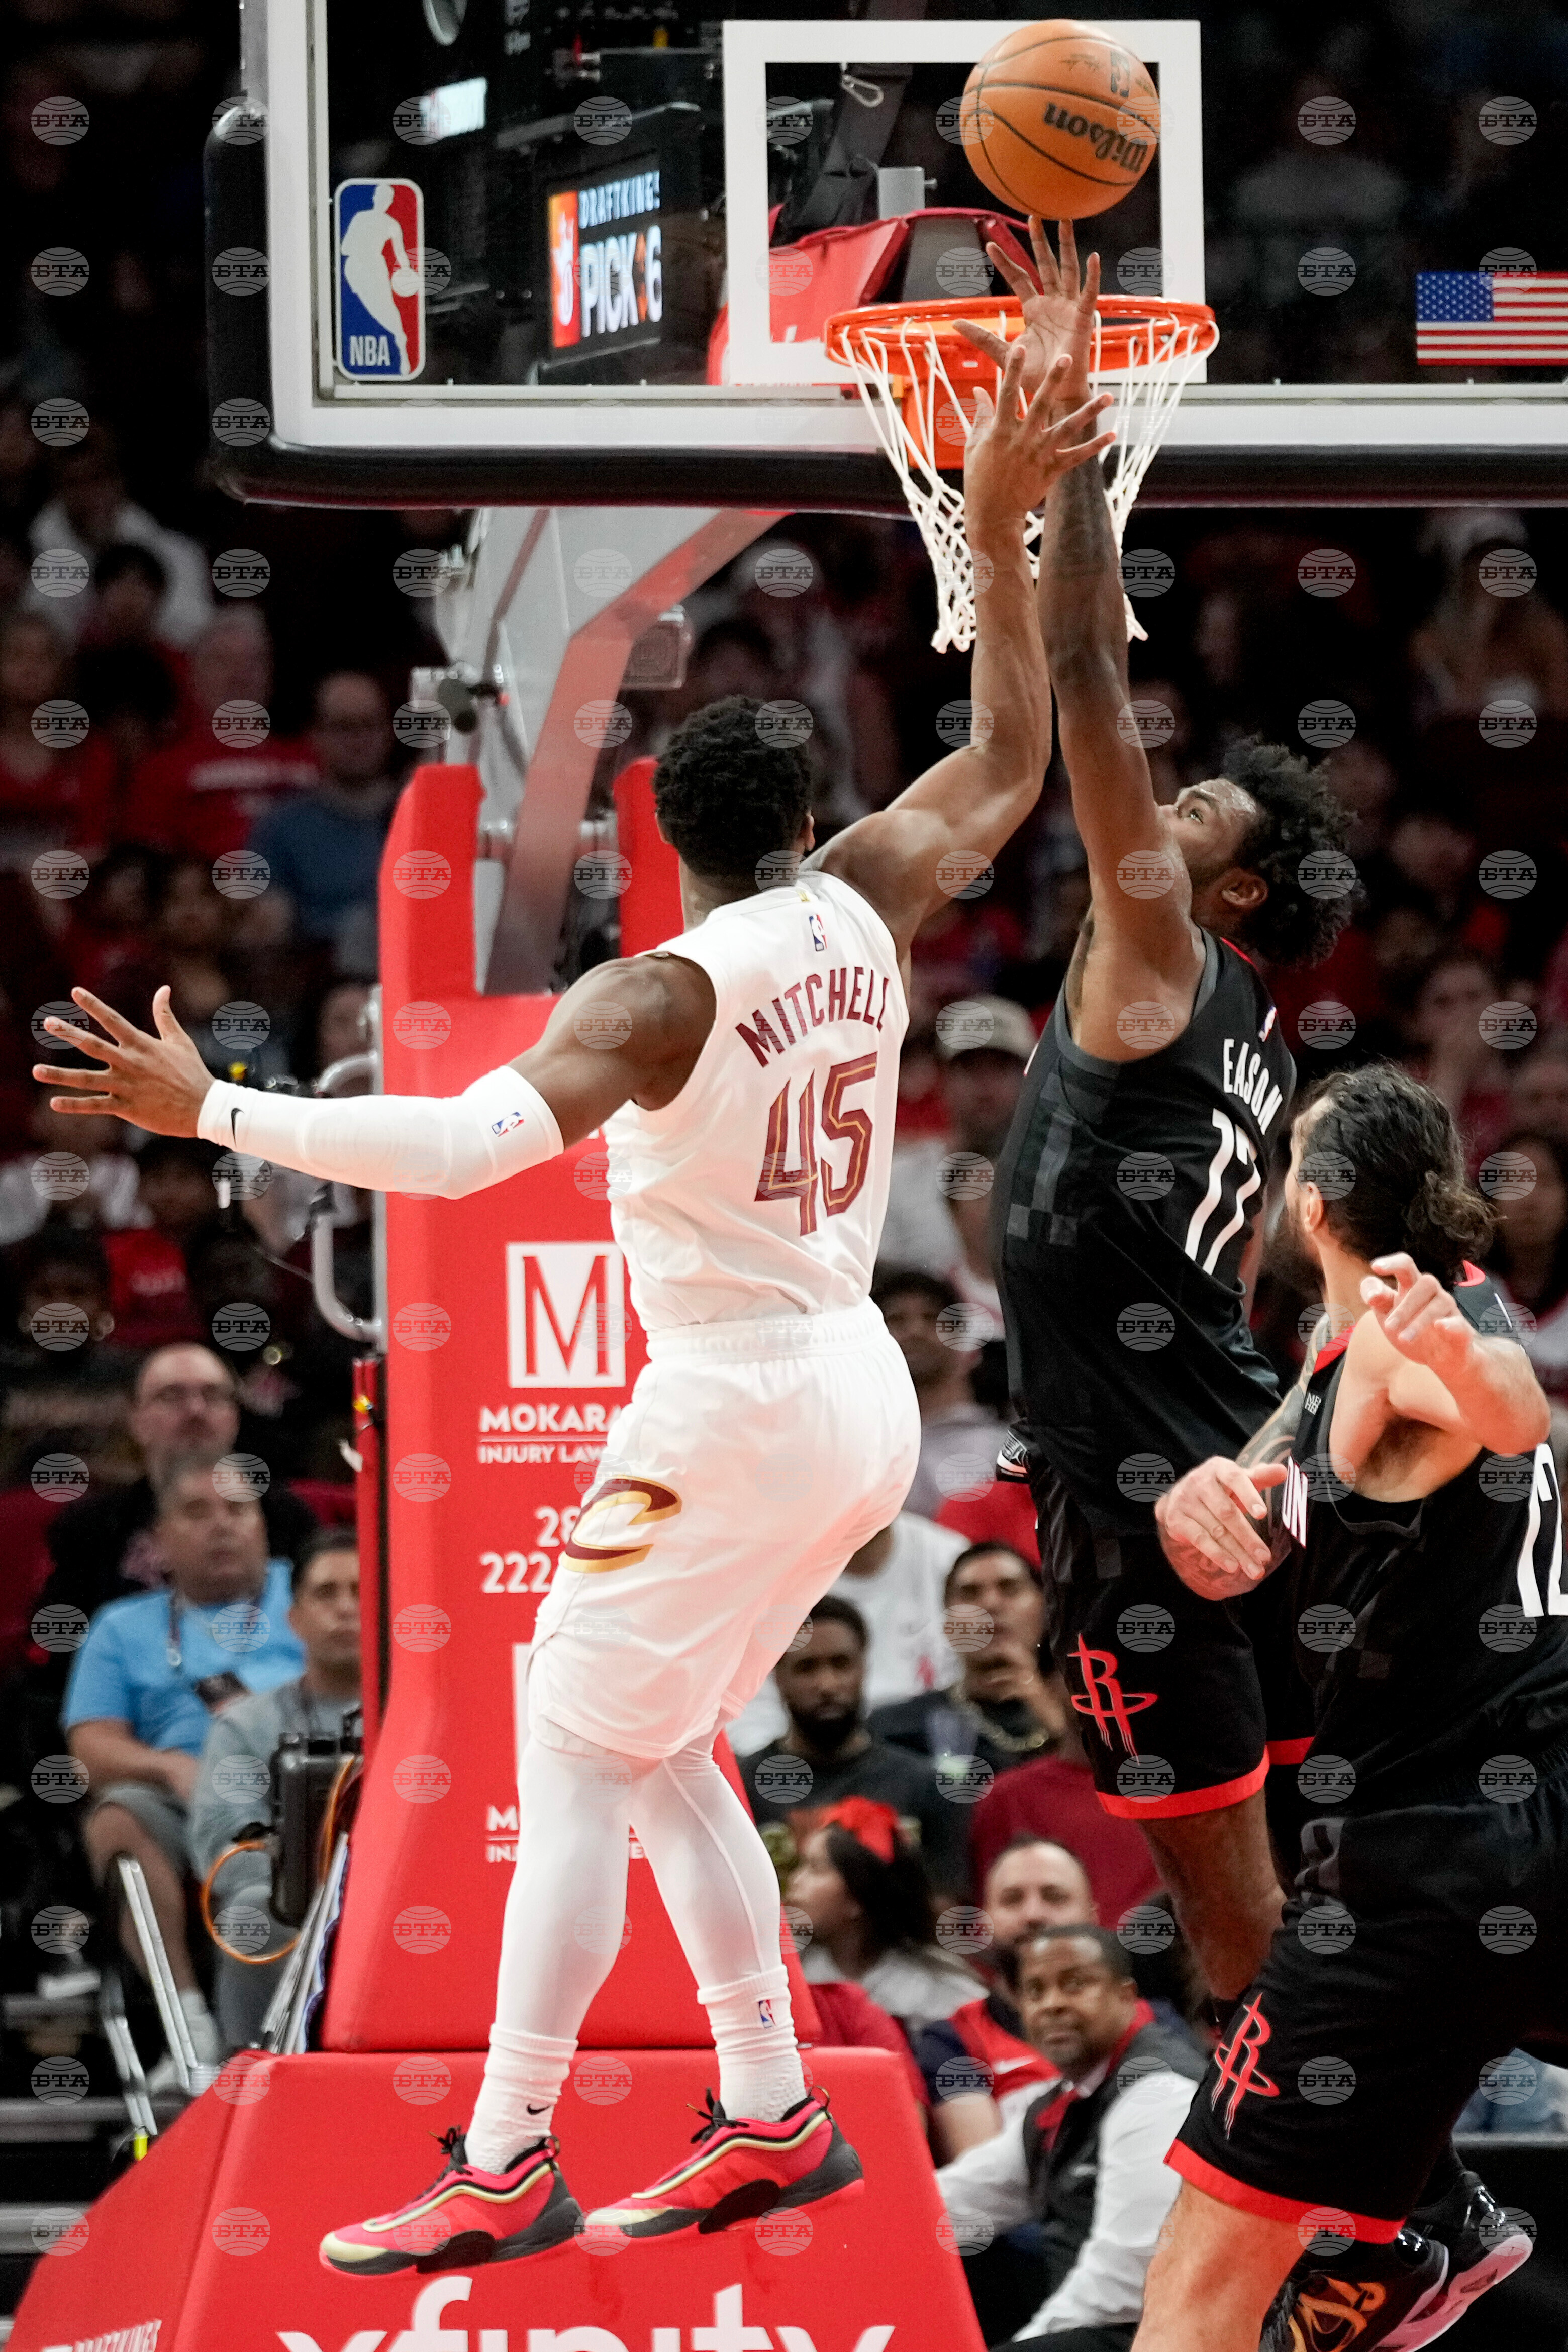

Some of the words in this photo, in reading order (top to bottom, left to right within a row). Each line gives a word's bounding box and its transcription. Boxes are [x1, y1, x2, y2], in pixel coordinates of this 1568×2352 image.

[350, 335, 390, 366] NBA
[735, 966, 890, 1068] MITCHELL
[1223, 1038, 1283, 1136] EASON
[754, 1051, 878, 1237] 45
[1185, 1108, 1261, 1276] 17
[478, 1444, 554, 1464] INJURY
